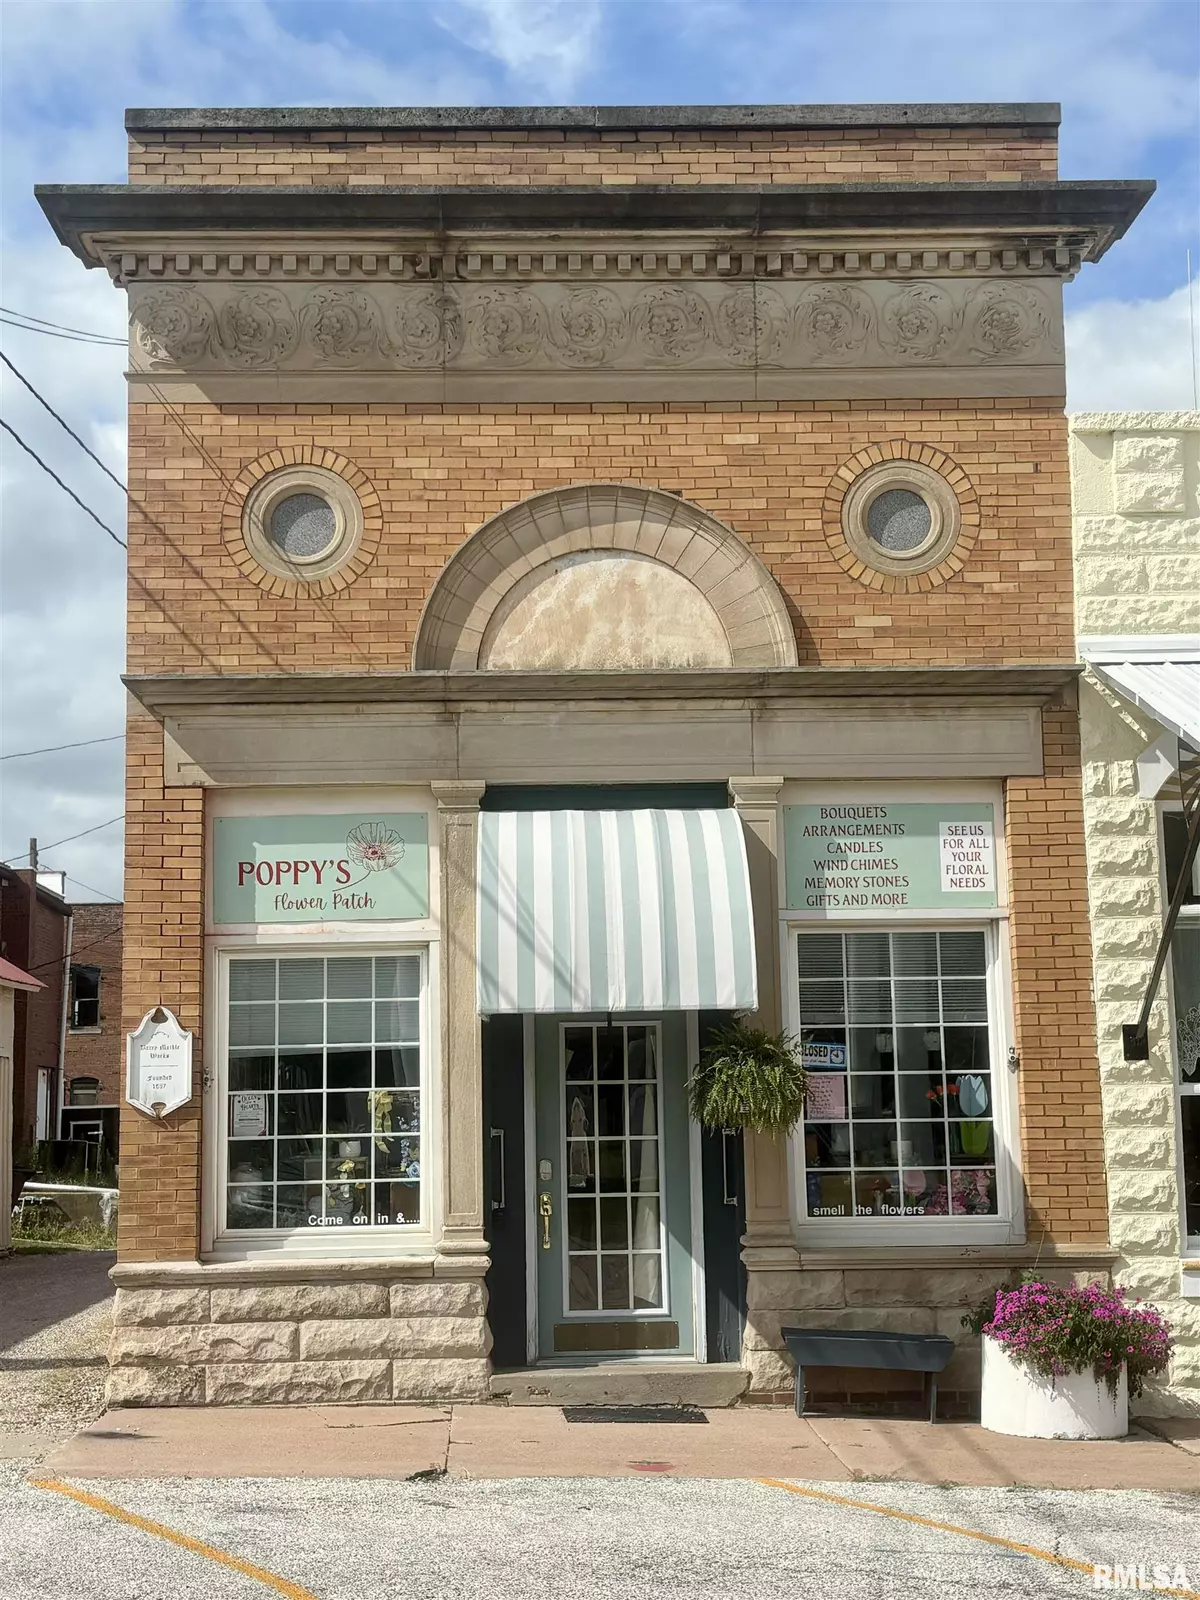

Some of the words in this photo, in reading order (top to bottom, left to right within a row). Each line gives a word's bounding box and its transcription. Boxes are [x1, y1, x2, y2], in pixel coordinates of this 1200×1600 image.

[820, 806, 887, 820] BOUQUETS
[802, 823, 905, 837] ARRANGEMENTS
[947, 825, 968, 836] SEE
[969, 825, 984, 836] US
[826, 841, 884, 854] CANDLES
[942, 839, 965, 849] FOR
[968, 838, 990, 849] ALL
[951, 851, 982, 862] YOUR
[813, 859, 848, 871] WIND
[850, 858, 899, 871] CHIMES
[945, 864, 989, 875] FLORAL
[237, 859, 351, 886] POPPY'S
[804, 876, 860, 889] MEMORY
[862, 875, 910, 888] STONES
[949, 877, 986, 888] NEEDS
[274, 892, 328, 911] Flower
[332, 891, 377, 910] Patch
[806, 894, 840, 907] GIFTS
[842, 893, 868, 906] AND
[871, 893, 909, 905] MORE
[813, 1204, 845, 1216] smell
[854, 1204, 873, 1215] the
[881, 1204, 925, 1216] flowers
[308, 1214, 344, 1226] Come
[352, 1214, 368, 1225] on
[377, 1213, 389, 1224] in
